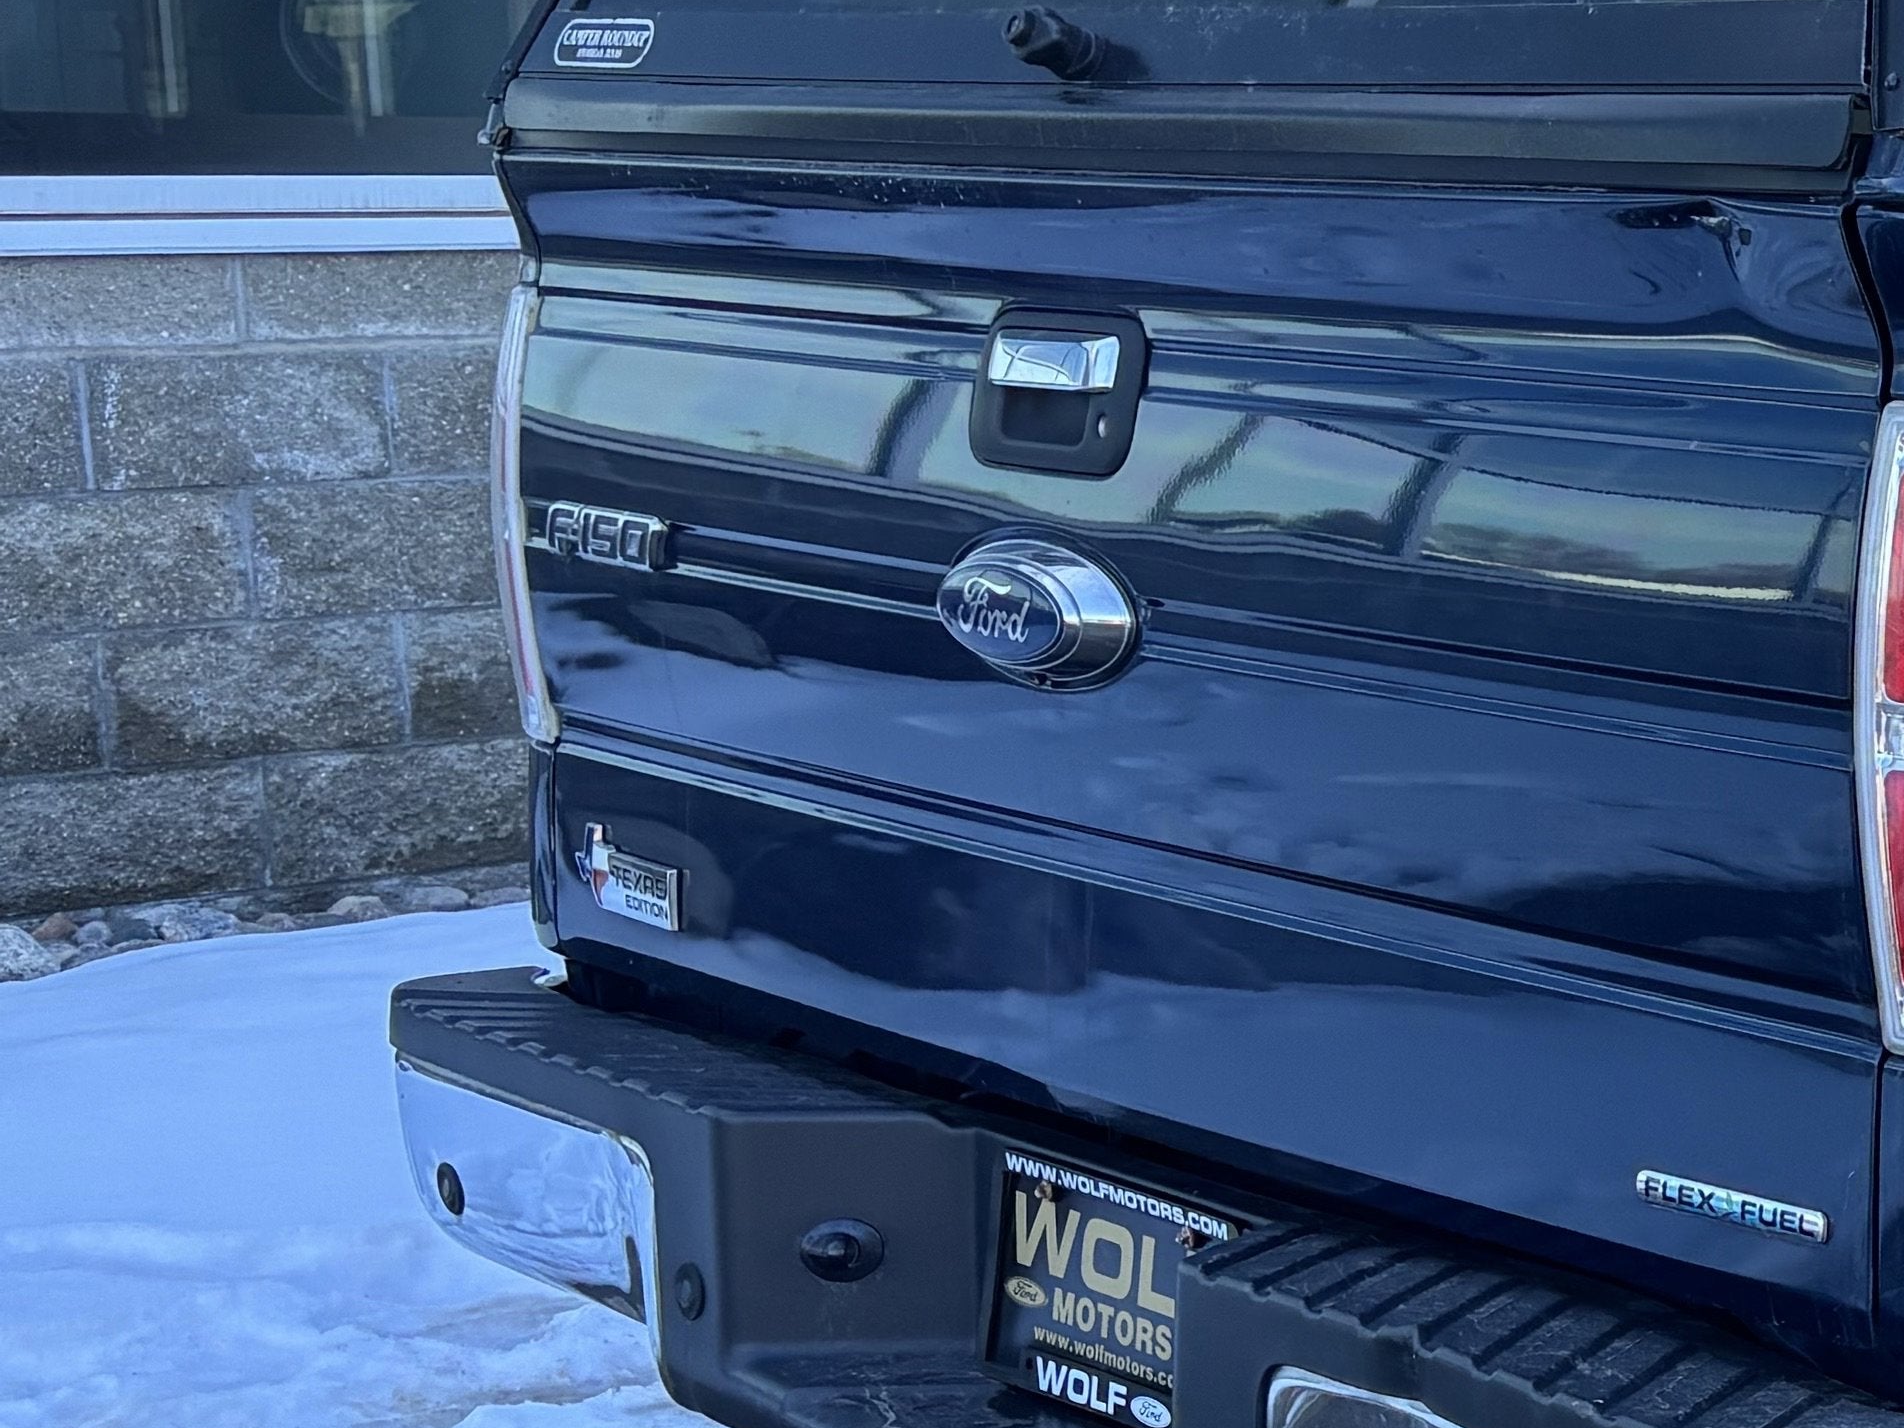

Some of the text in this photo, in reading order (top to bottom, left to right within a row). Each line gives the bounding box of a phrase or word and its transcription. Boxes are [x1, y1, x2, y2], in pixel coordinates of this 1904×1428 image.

[957, 575, 1031, 643] Ford
[609, 864, 668, 901] TEXAS
[625, 895, 668, 920] EDITION
[1005, 1152, 1229, 1241] WWW.WOLFMOTORS.COM
[1643, 1175, 1816, 1238] FLEX FUEL
[1014, 1189, 1176, 1319] WOL
[1013, 1283, 1038, 1302] Ford
[1051, 1287, 1172, 1362] MOTORS
[1036, 1355, 1128, 1416] WOLF
[1139, 1400, 1164, 1423] Ford
